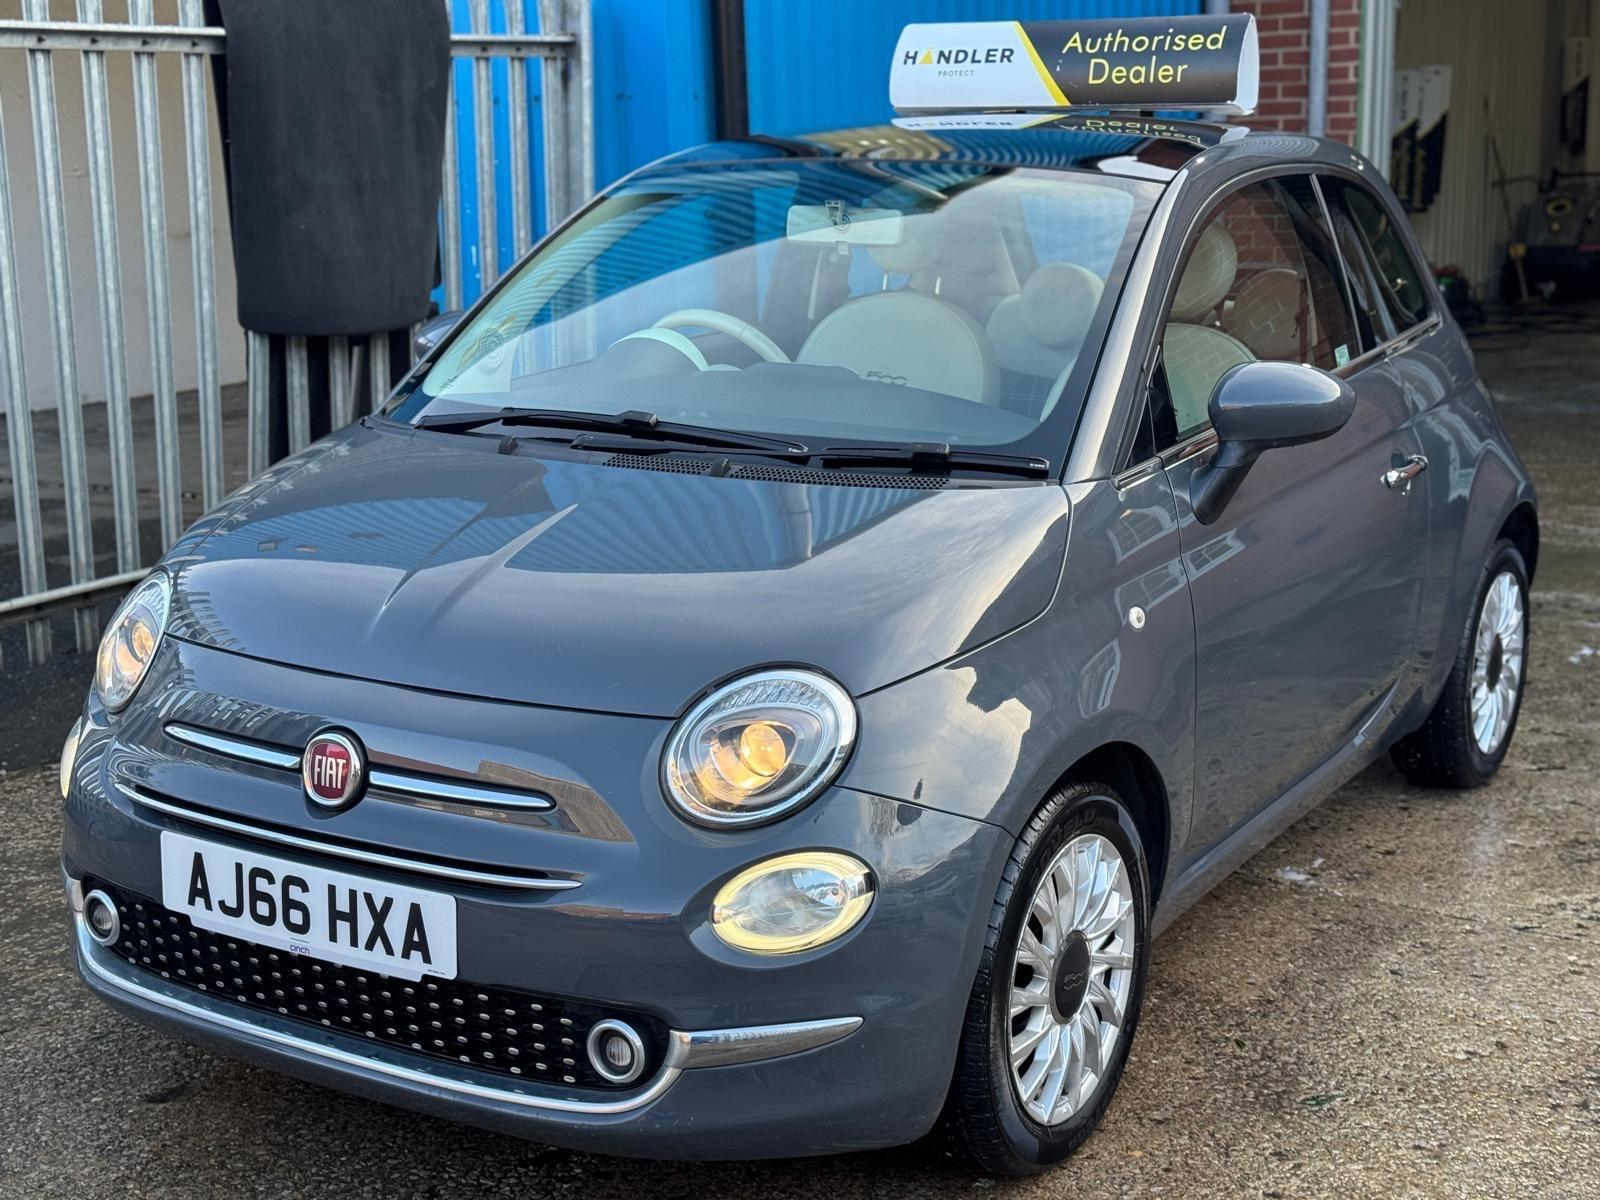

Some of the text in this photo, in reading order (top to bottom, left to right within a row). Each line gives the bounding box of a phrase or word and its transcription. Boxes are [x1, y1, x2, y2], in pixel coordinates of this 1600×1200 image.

[1062, 26, 1227, 54] Authorised
[1088, 56, 1188, 85] Dealer
[314, 755, 347, 790] FIAT
[187, 851, 433, 966] AJ66 HXA
